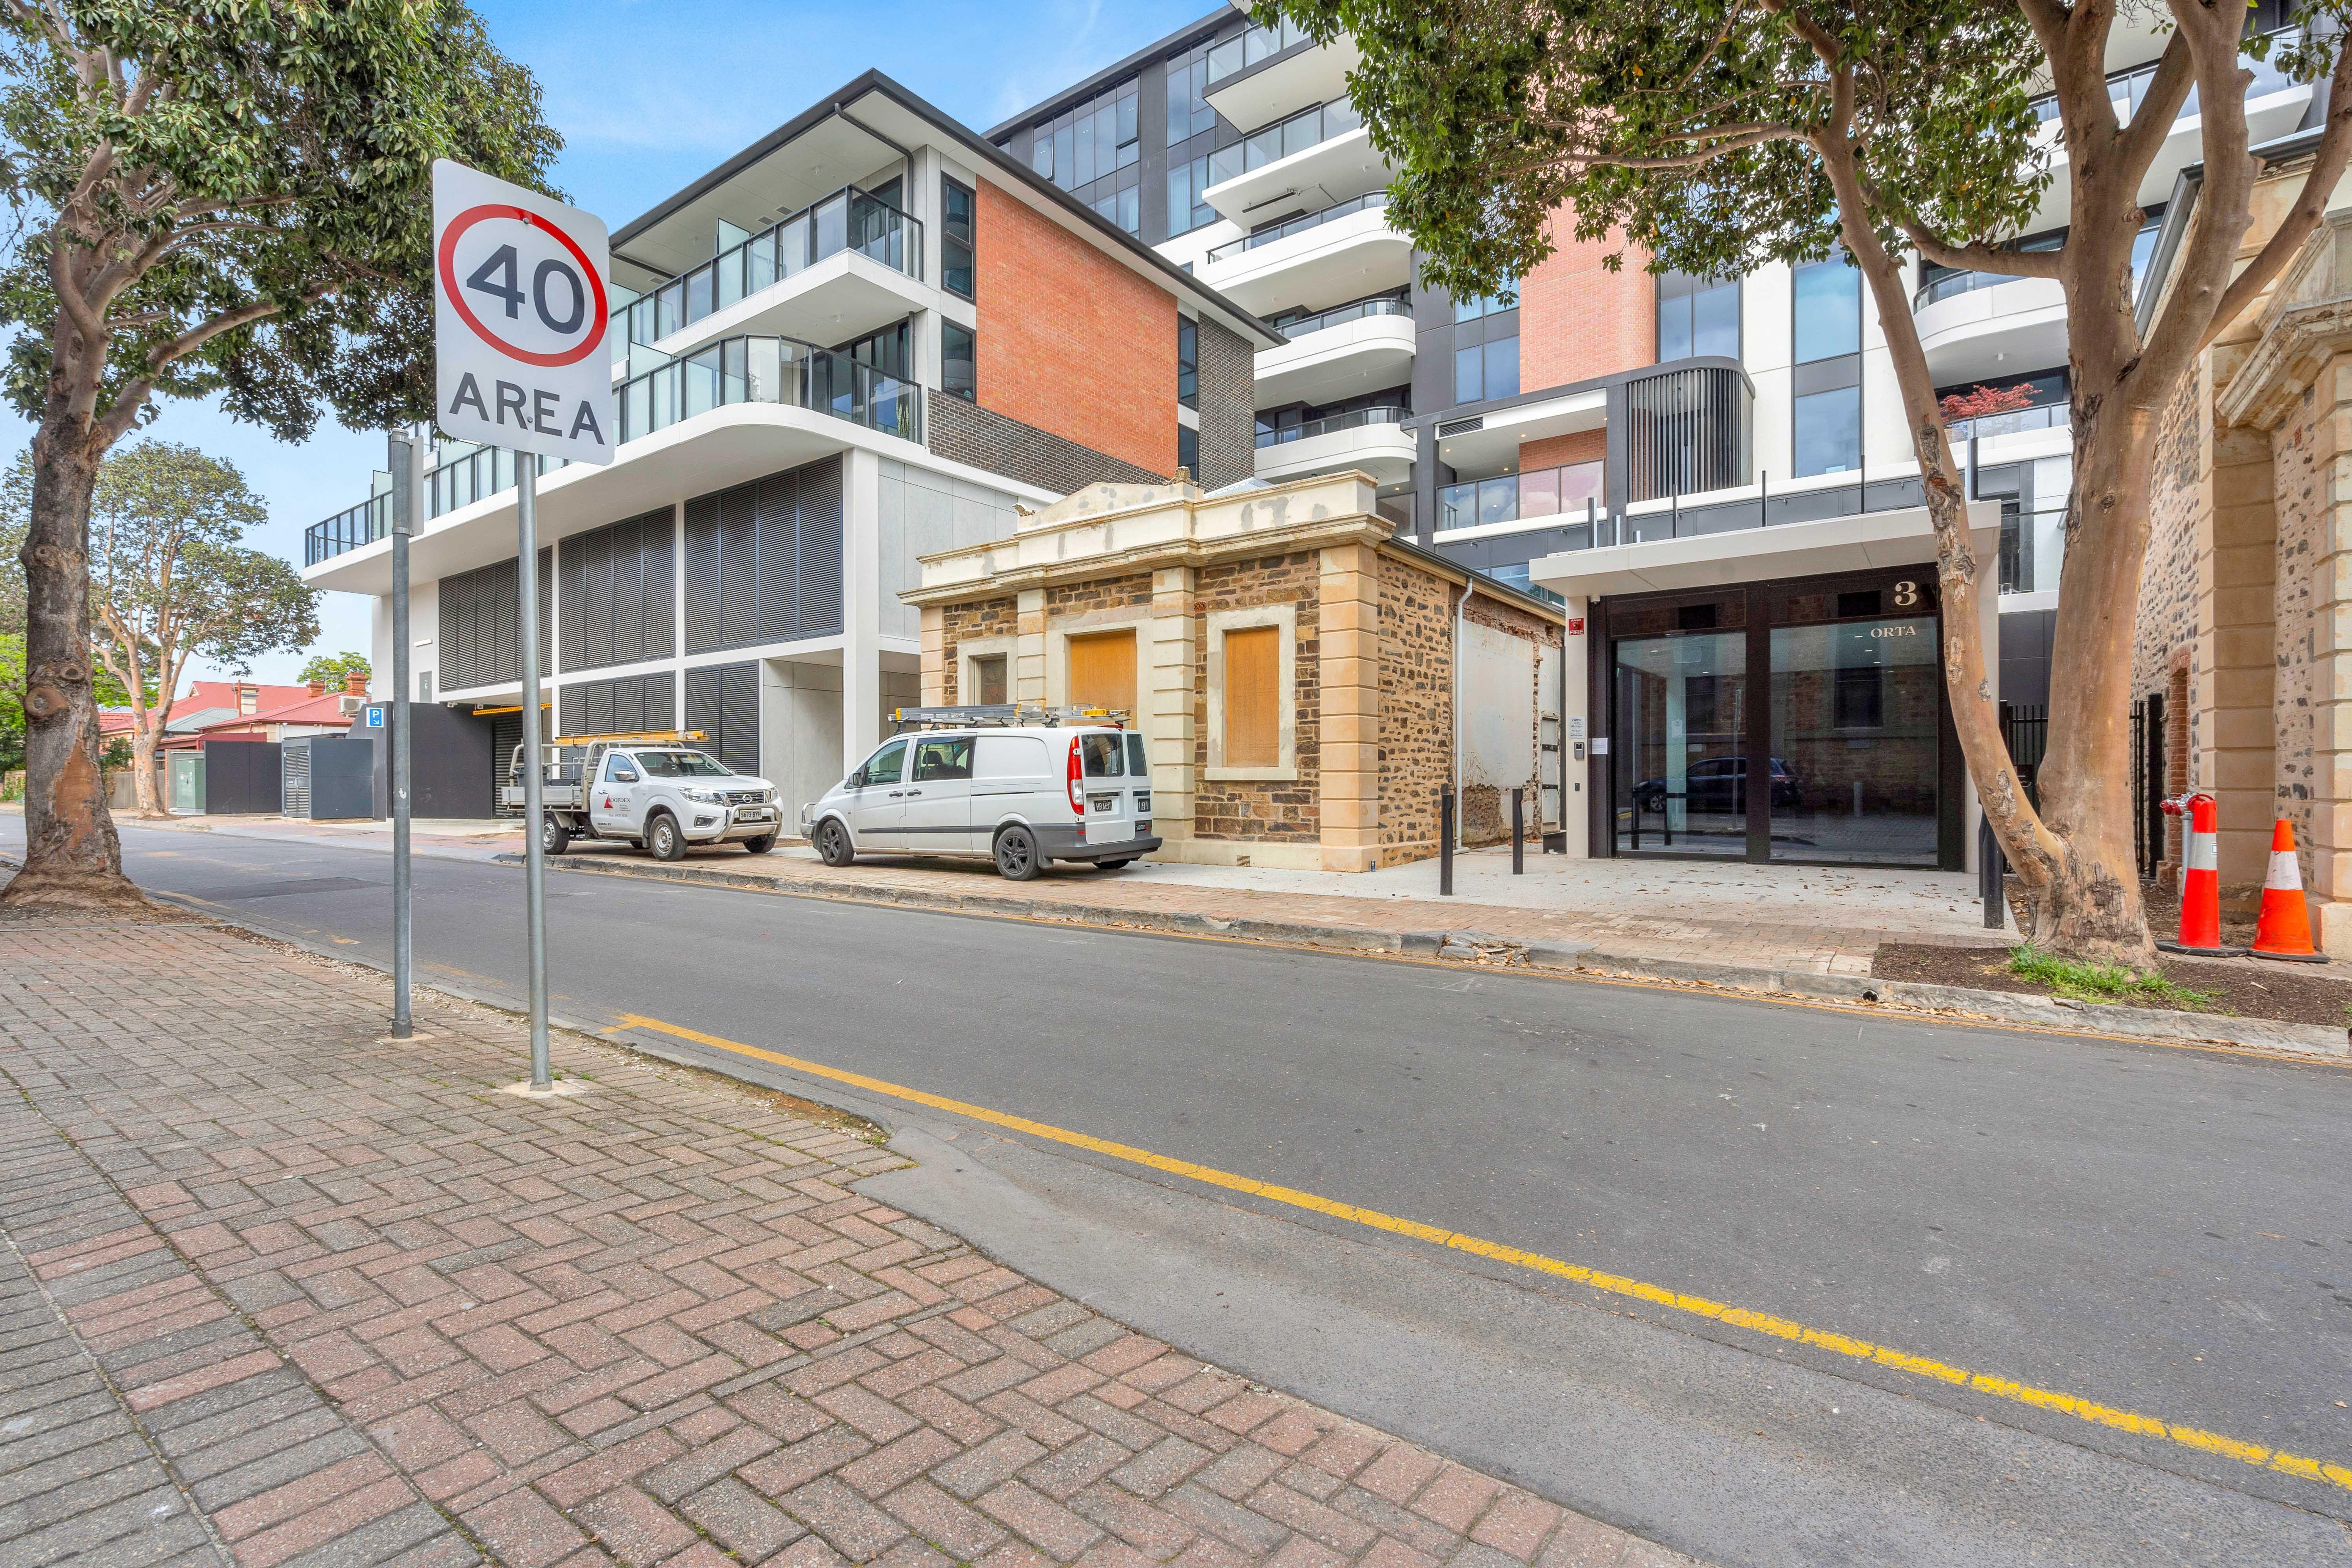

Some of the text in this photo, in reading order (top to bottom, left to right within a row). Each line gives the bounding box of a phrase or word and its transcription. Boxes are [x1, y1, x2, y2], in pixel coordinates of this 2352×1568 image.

[466, 244, 584, 334] 40
[449, 372, 604, 445] AREA
[1895, 581, 1917, 606] 3
[1871, 626, 1916, 638] ORTA
